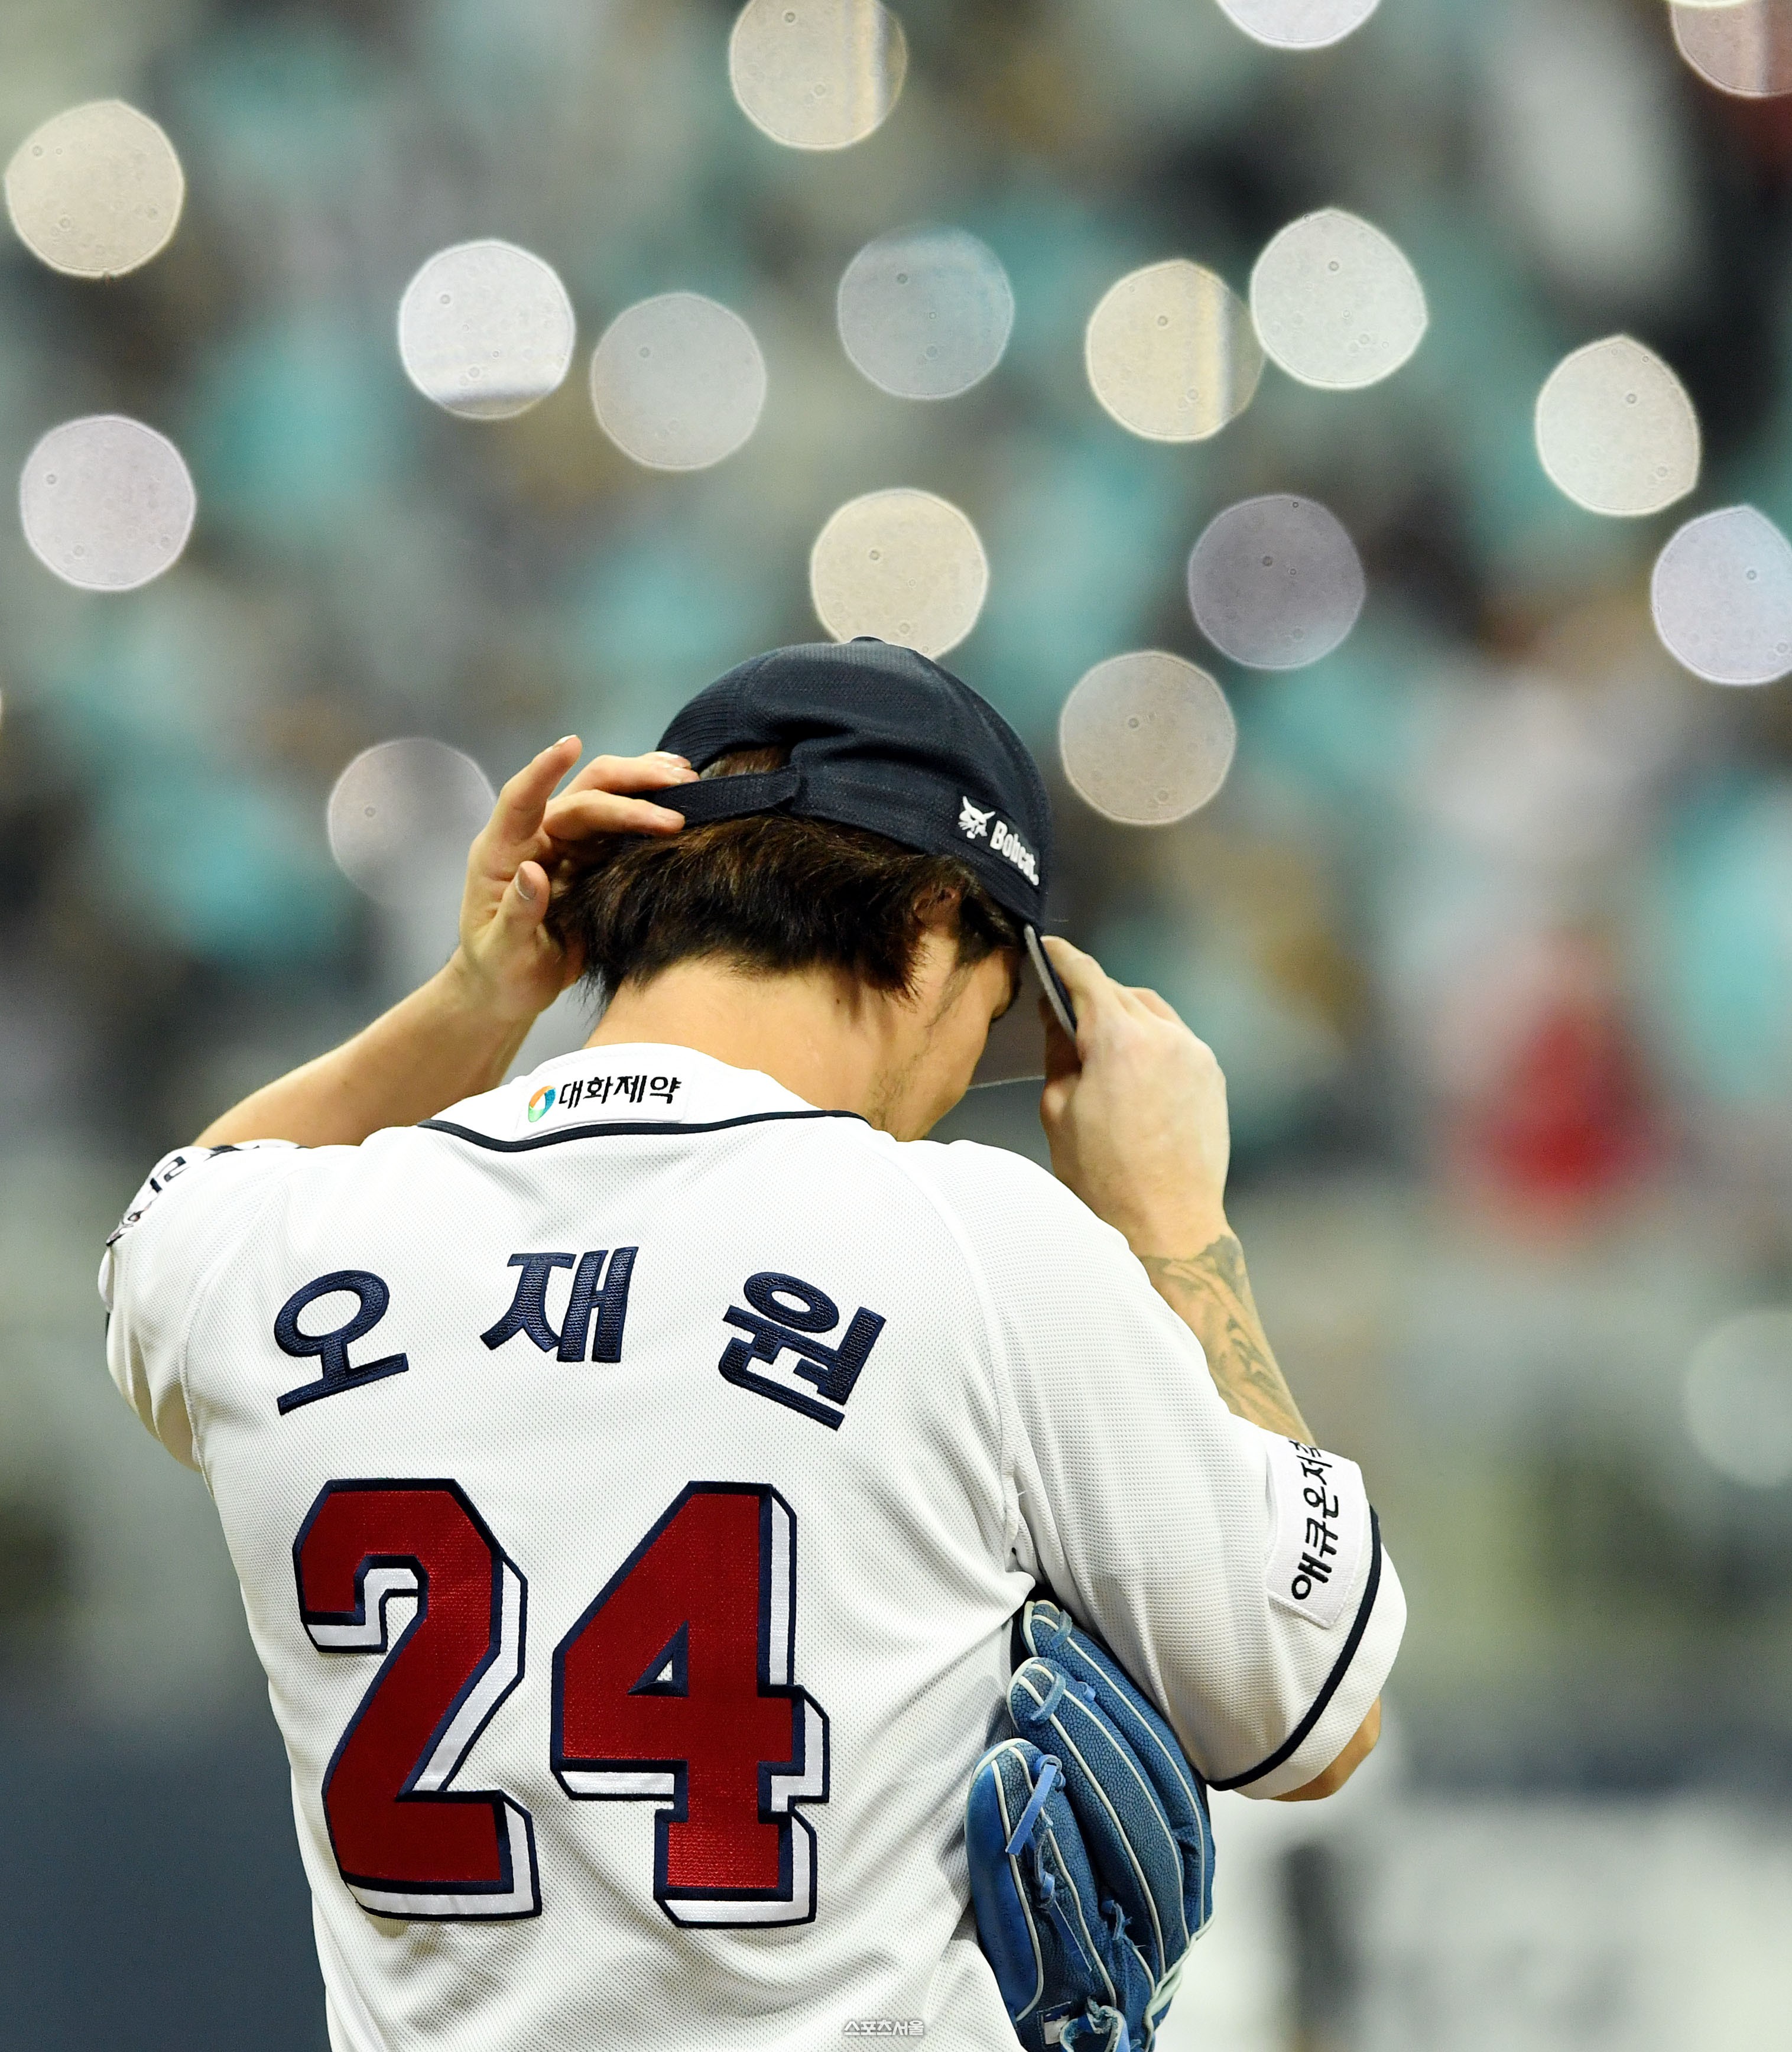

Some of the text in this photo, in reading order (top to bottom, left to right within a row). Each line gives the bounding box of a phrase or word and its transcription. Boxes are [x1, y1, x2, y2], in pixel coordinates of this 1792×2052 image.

[559, 1075, 681, 1109] 대화제약
[274, 1246, 886, 1431] 오재원
[292, 1478, 830, 1928] 24
